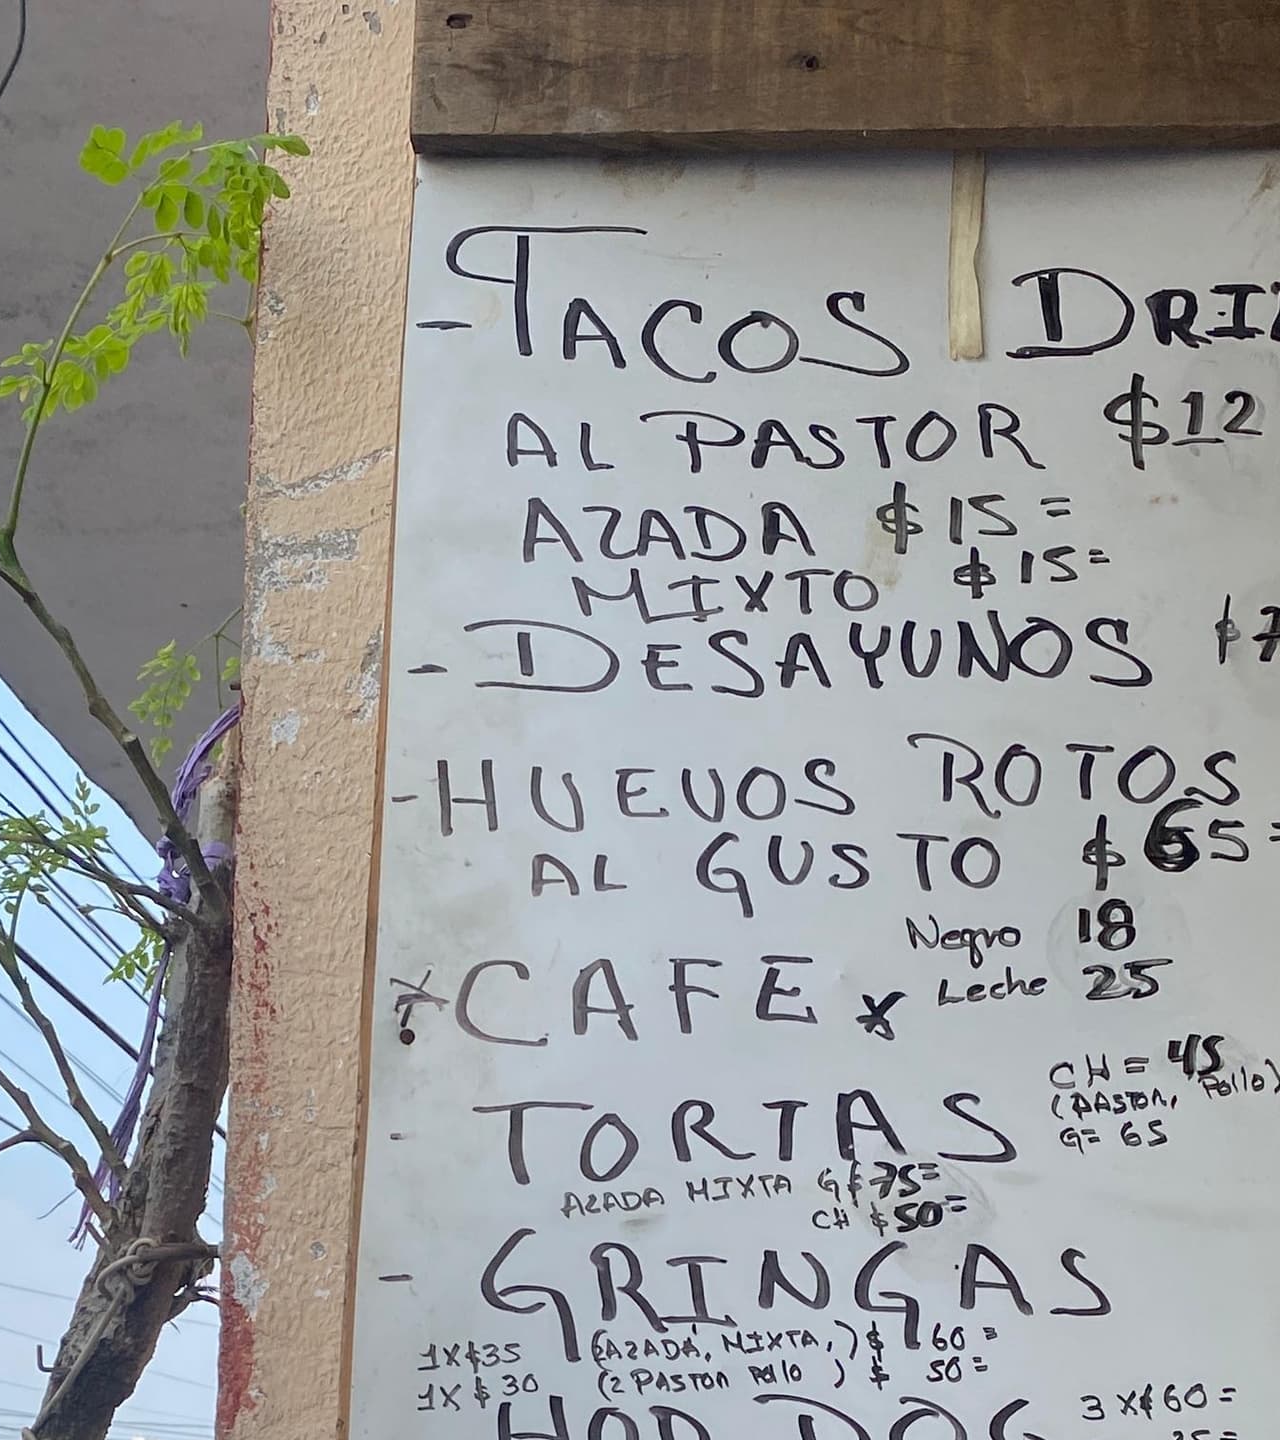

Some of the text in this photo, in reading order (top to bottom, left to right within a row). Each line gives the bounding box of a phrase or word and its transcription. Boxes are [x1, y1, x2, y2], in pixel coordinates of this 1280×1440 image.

[446, 226, 910, 383] TACOS
[507, 413, 615, 471] AL
[640, 403, 1046, 473] PASTOR
[571, 568, 879, 624] MIXTO
[464, 610, 1152, 698] DESAYUNOS
[907, 733, 1240, 819] ROTOS
[532, 854, 627, 896] AL
[696, 832, 1000, 918] GUSTO
[1079, 898, 1136, 951] 18
[456, 955, 818, 1046] CAFE
[938, 959, 1173, 1006] Leche 25
[472, 1088, 1018, 1186] TORTAS
[1120, 1120, 1167, 1147] 65
[481, 1228, 1111, 1367] GRINGAS
